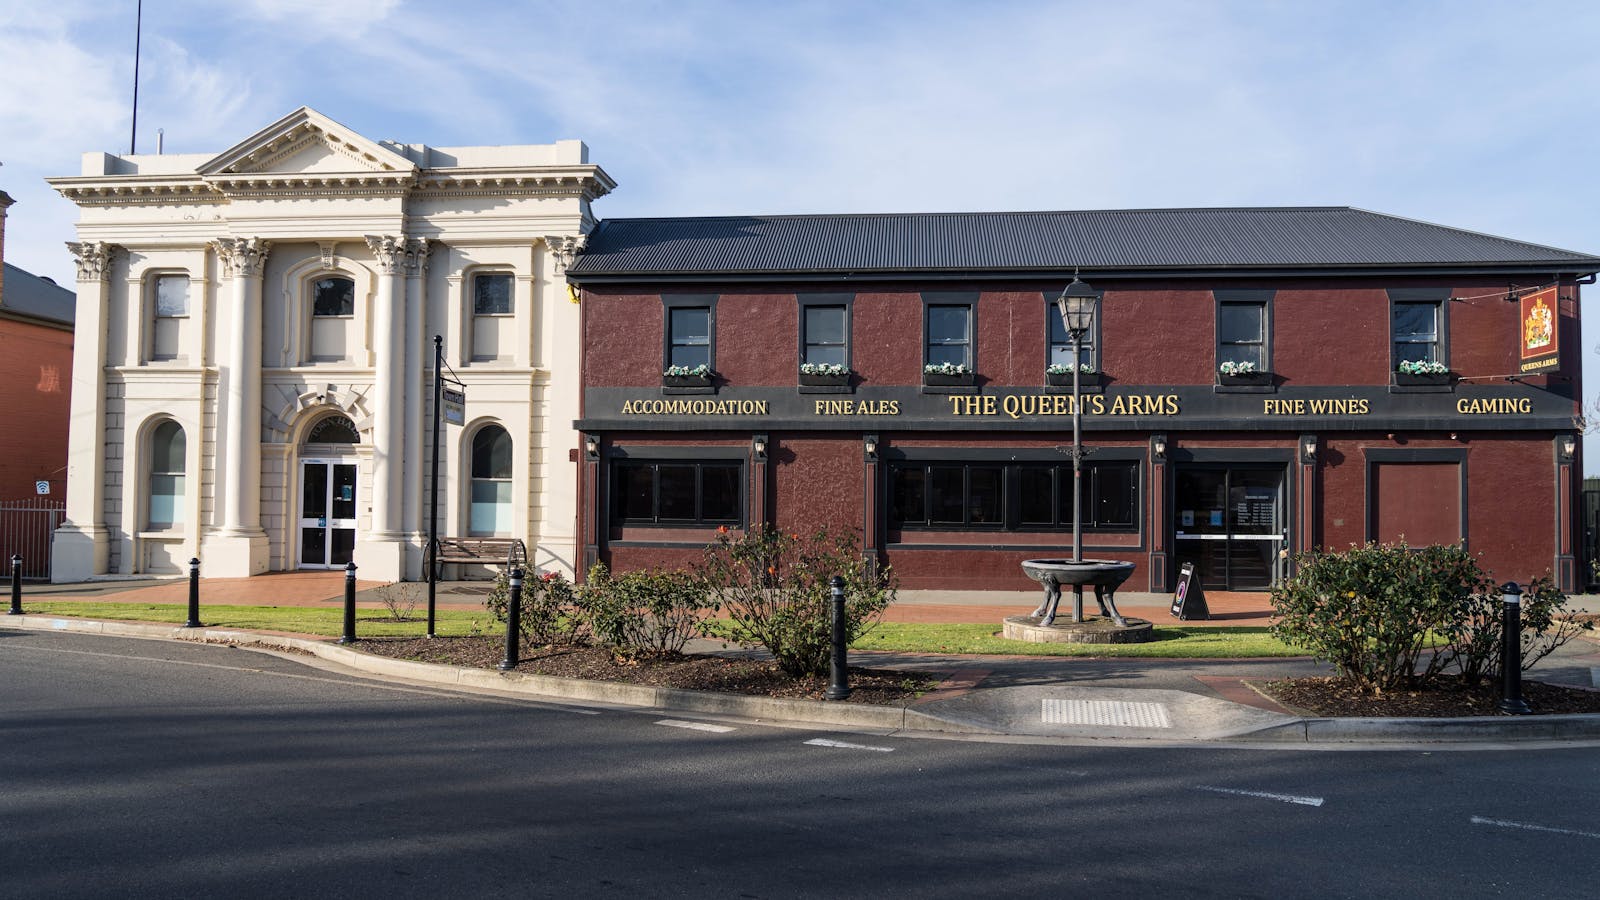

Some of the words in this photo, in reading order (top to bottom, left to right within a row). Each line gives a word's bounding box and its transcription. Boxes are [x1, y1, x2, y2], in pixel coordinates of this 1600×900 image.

[1521, 361, 1542, 372] QUEENS
[1542, 358, 1558, 368] ARMS
[622, 399, 768, 415] ACCOMMODATION
[815, 399, 853, 415] FINE
[857, 399, 899, 415] ALES
[949, 395, 997, 415] THE
[1003, 394, 1104, 419] QUEEN'S
[1110, 394, 1179, 415] ARMS
[1264, 398, 1304, 415] FINE
[1308, 398, 1369, 415] WINES
[1456, 397, 1531, 414] GAMING
